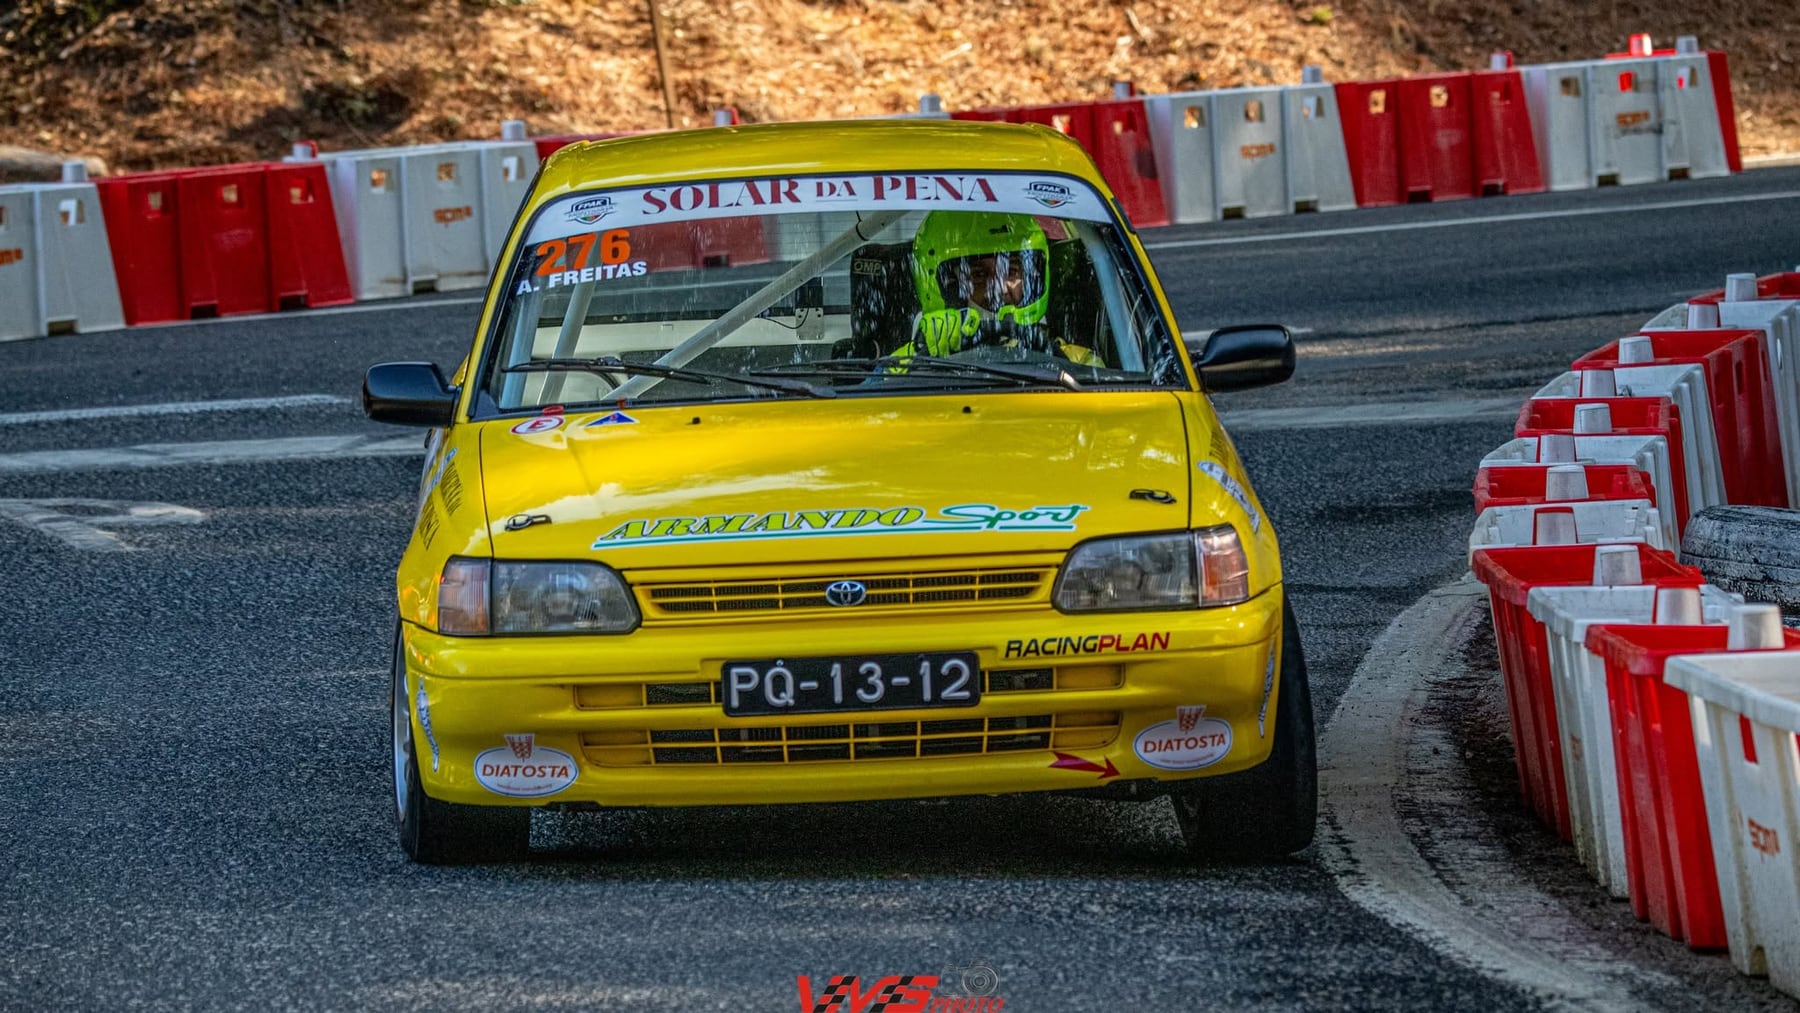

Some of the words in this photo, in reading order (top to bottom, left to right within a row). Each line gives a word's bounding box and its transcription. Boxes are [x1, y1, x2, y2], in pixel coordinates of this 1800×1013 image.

[642, 179, 802, 215] SOLAR
[815, 180, 856, 198] DA
[872, 175, 999, 203] PENA
[536, 229, 631, 278] 276
[516, 279, 539, 295] A.
[549, 261, 647, 288] FREITAS
[600, 507, 923, 540] ARMANDO
[923, 504, 1090, 531] Sport
[1004, 631, 1170, 658] RACINGPLAN
[729, 659, 971, 708] PQ-13-12
[1143, 733, 1226, 754] DIATOSTA
[482, 763, 568, 778] DIATOSTA
